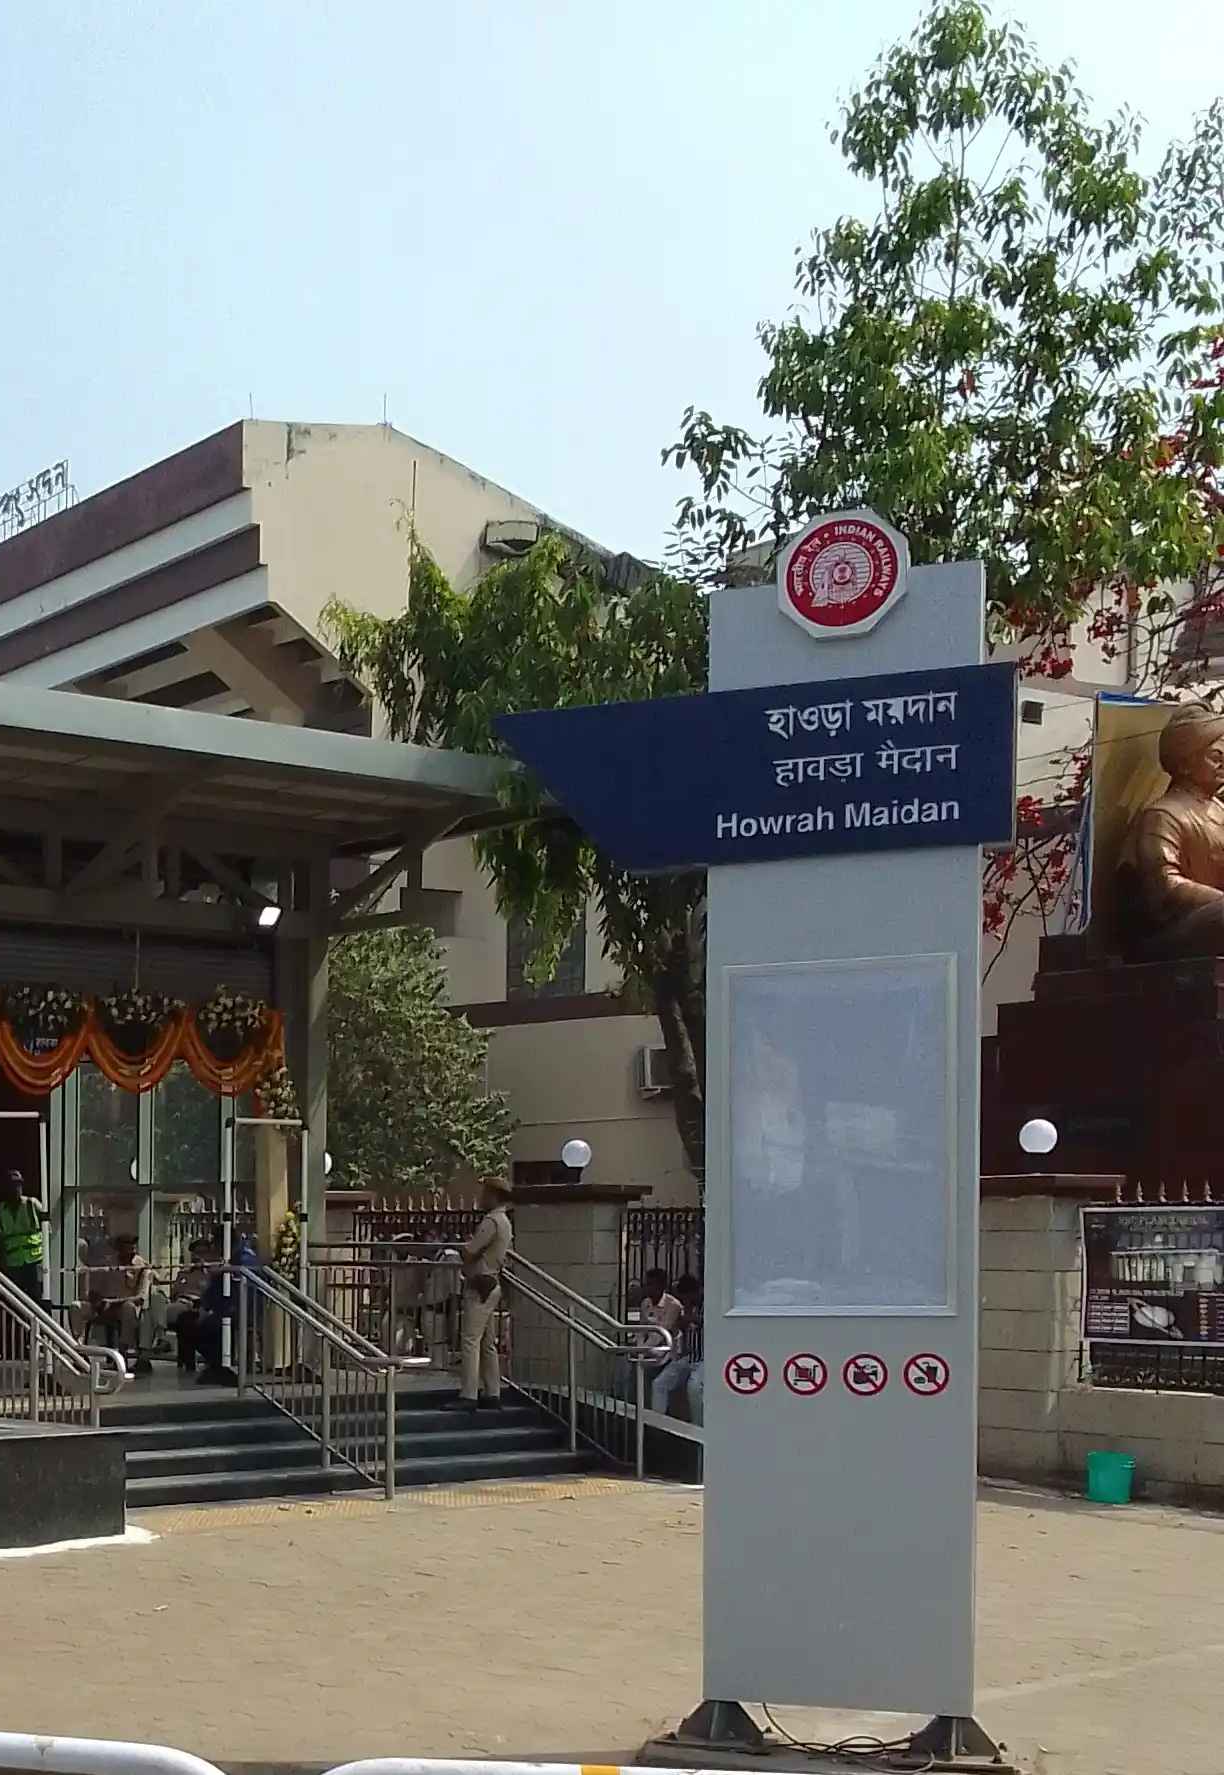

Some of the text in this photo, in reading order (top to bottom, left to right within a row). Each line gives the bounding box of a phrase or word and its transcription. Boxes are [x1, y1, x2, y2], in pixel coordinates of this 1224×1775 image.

[834, 526, 893, 597] INDIAN RAILWAYS
[764, 690, 959, 740] হাওড়া ময়দান
[773, 739, 961, 787] हावड़ा मैदान
[715, 797, 961, 839] Howrah Maidan
